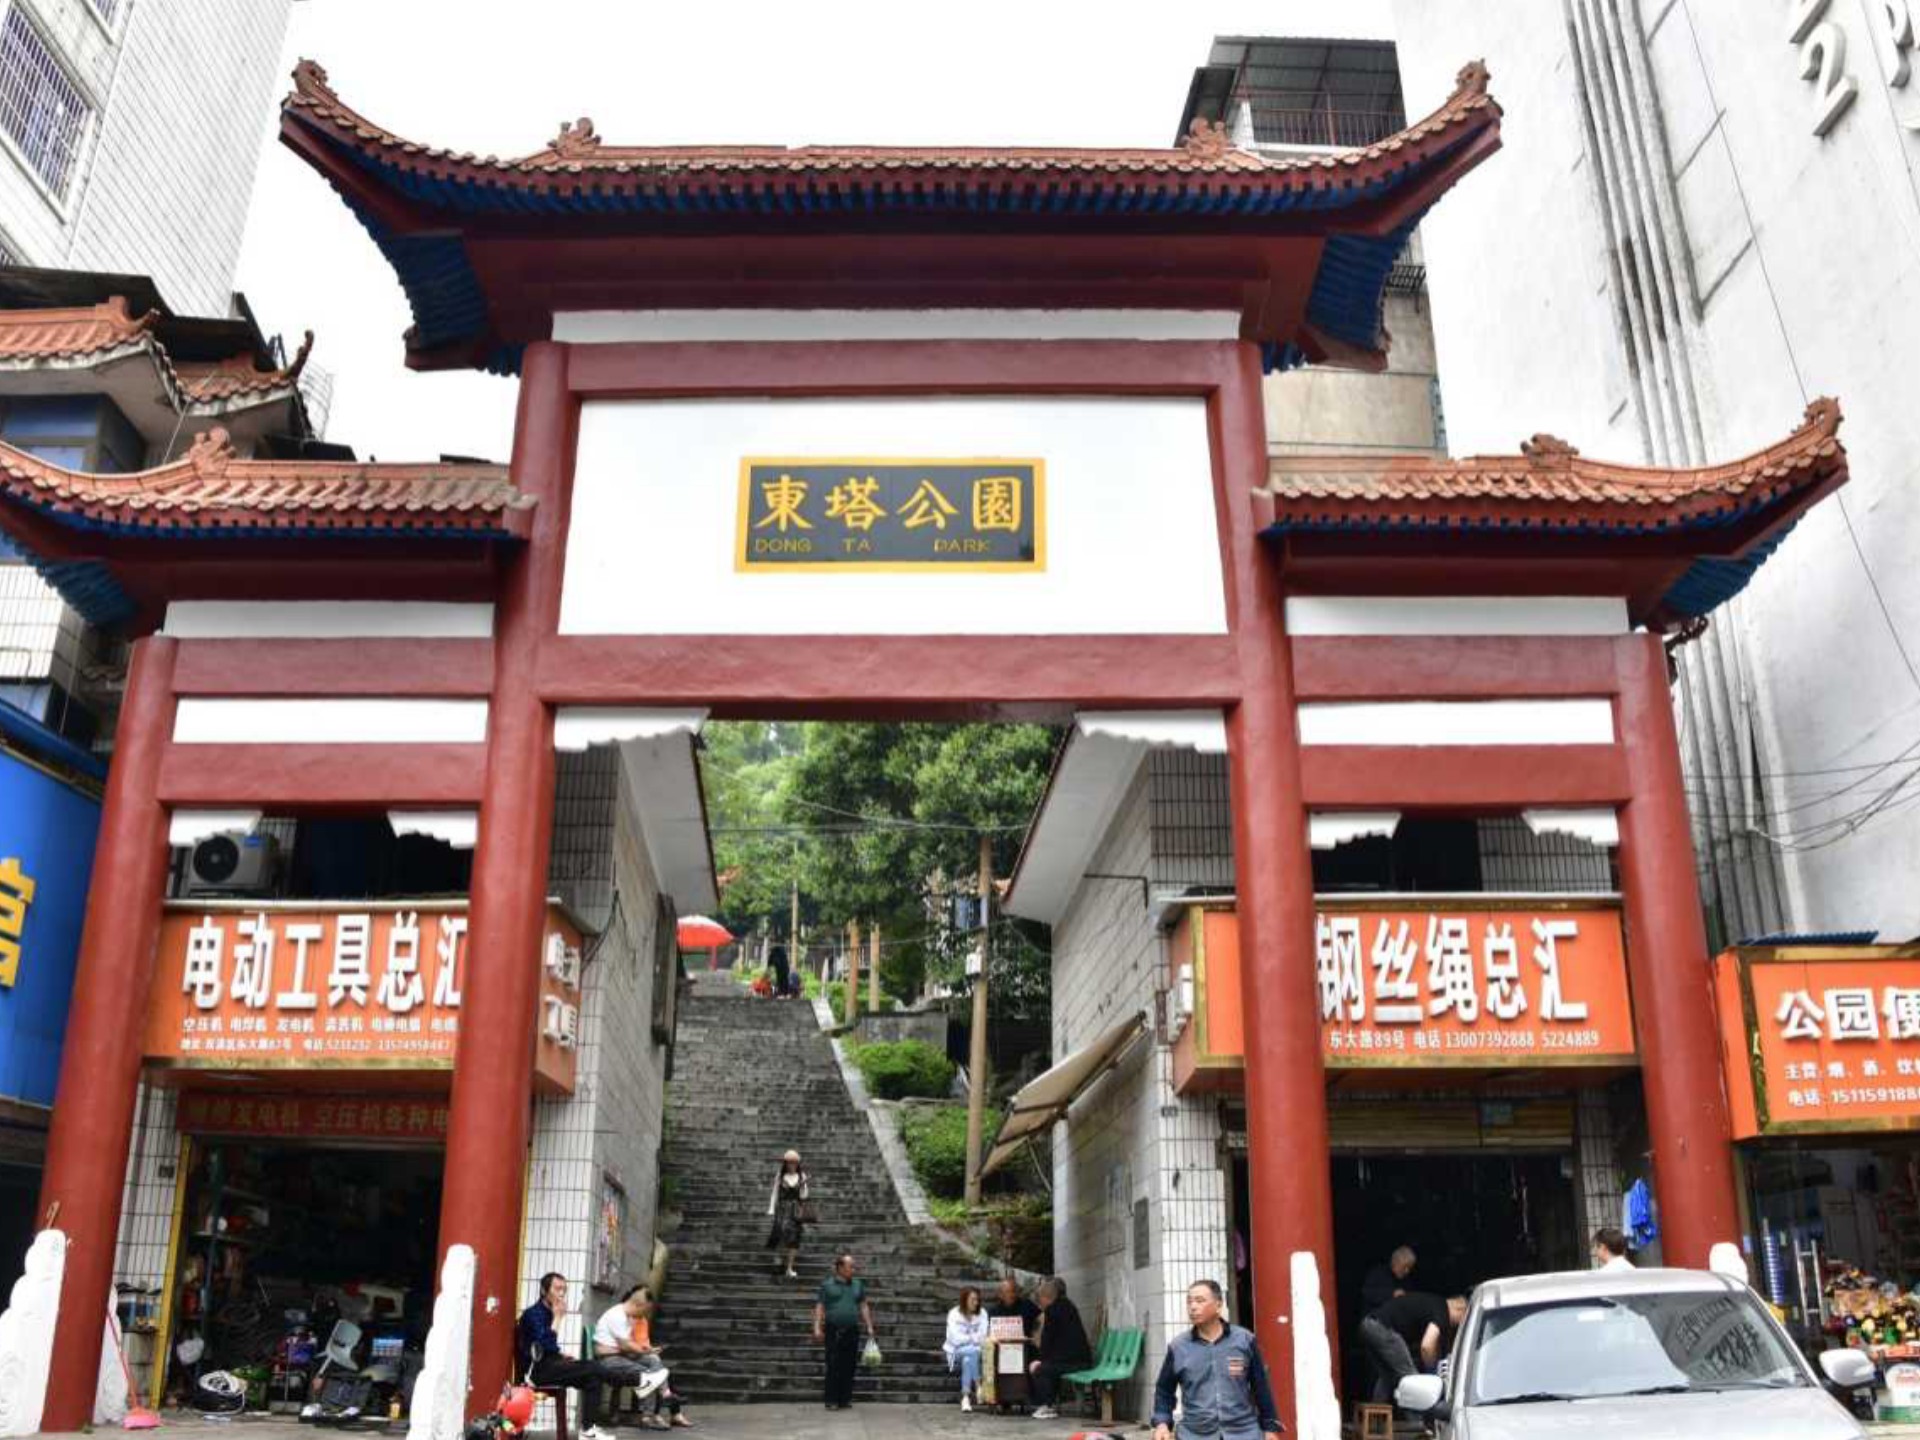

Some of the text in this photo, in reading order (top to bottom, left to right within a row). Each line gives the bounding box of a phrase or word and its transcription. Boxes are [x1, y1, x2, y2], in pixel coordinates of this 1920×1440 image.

[753, 474, 1022, 532] 東塔公園
[755, 538, 812, 552] DONG
[842, 537, 871, 552] TA
[182, 911, 468, 1011] 电动工具总汇
[1315, 914, 1588, 1023] 钢丝绳总汇
[1330, 1029, 1405, 1049] 东大路89号
